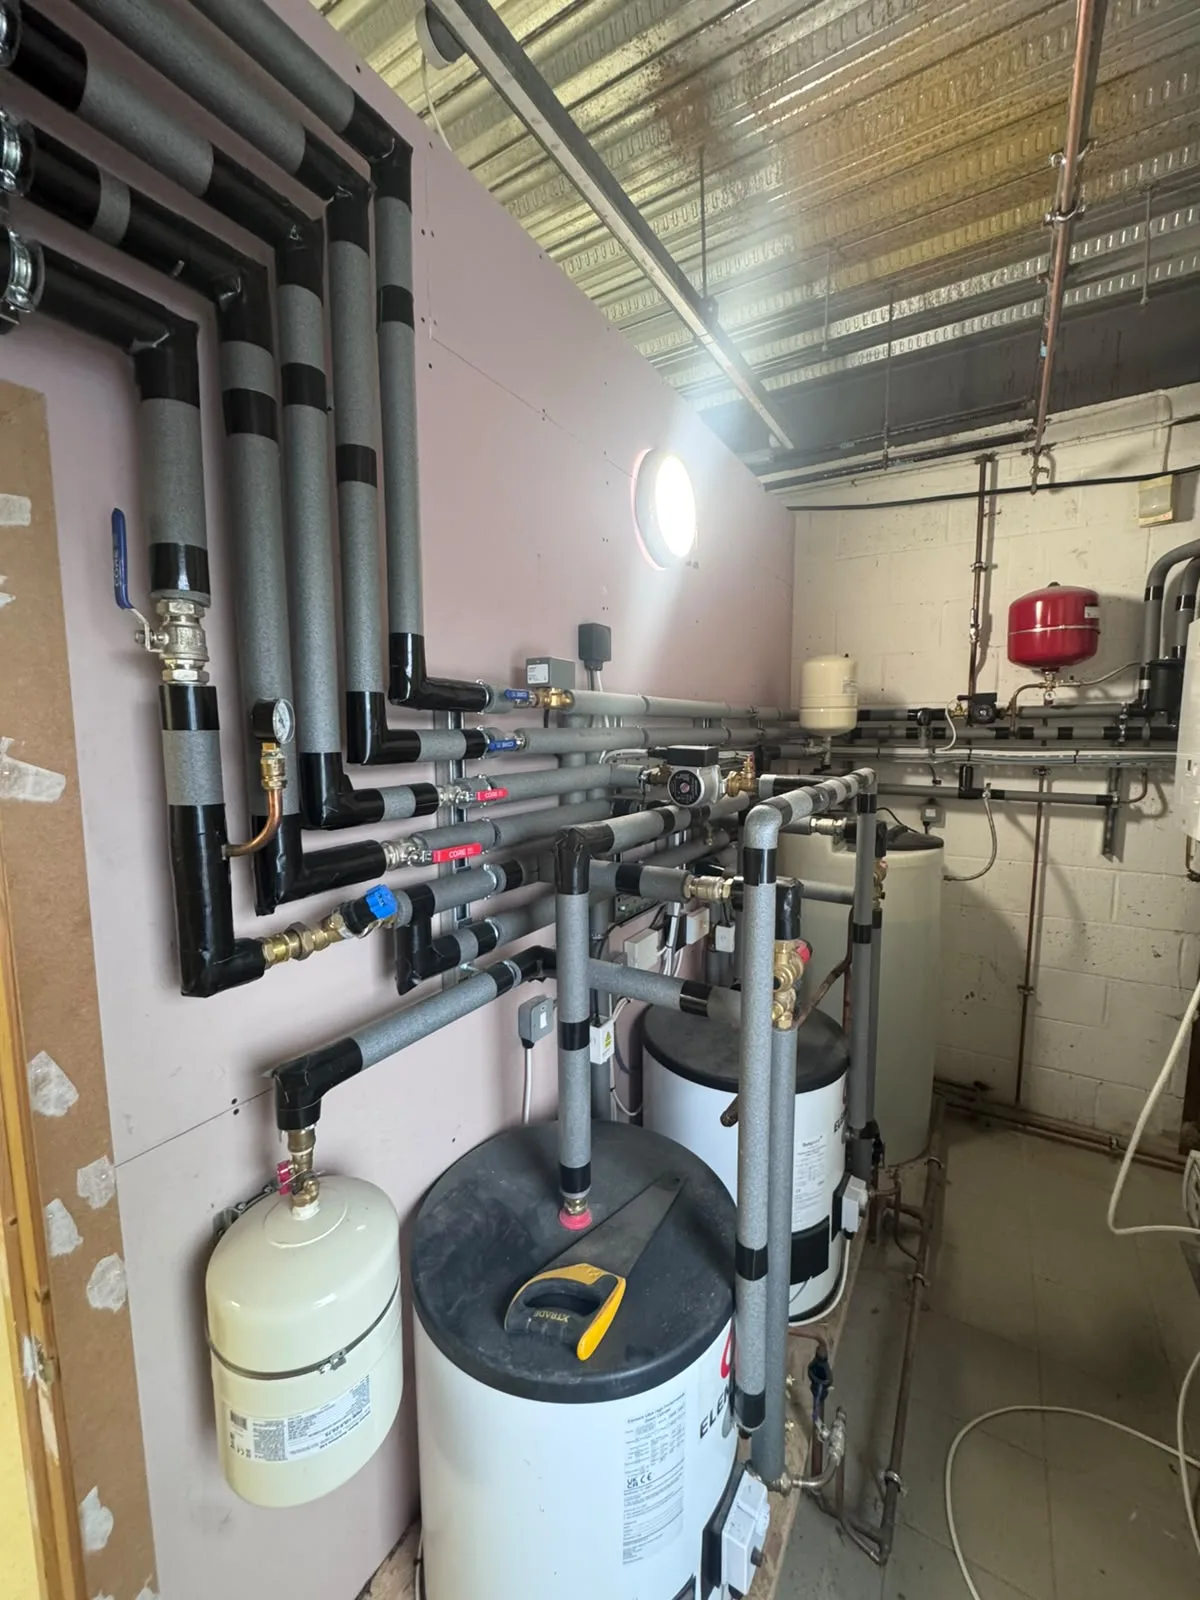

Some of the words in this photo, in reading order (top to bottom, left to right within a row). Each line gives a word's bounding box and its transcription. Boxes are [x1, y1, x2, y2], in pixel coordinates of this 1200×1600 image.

[484, 790, 498, 799] CORE
[448, 847, 467, 859] CORE
[533, 1309, 571, 1323] XTRADE
